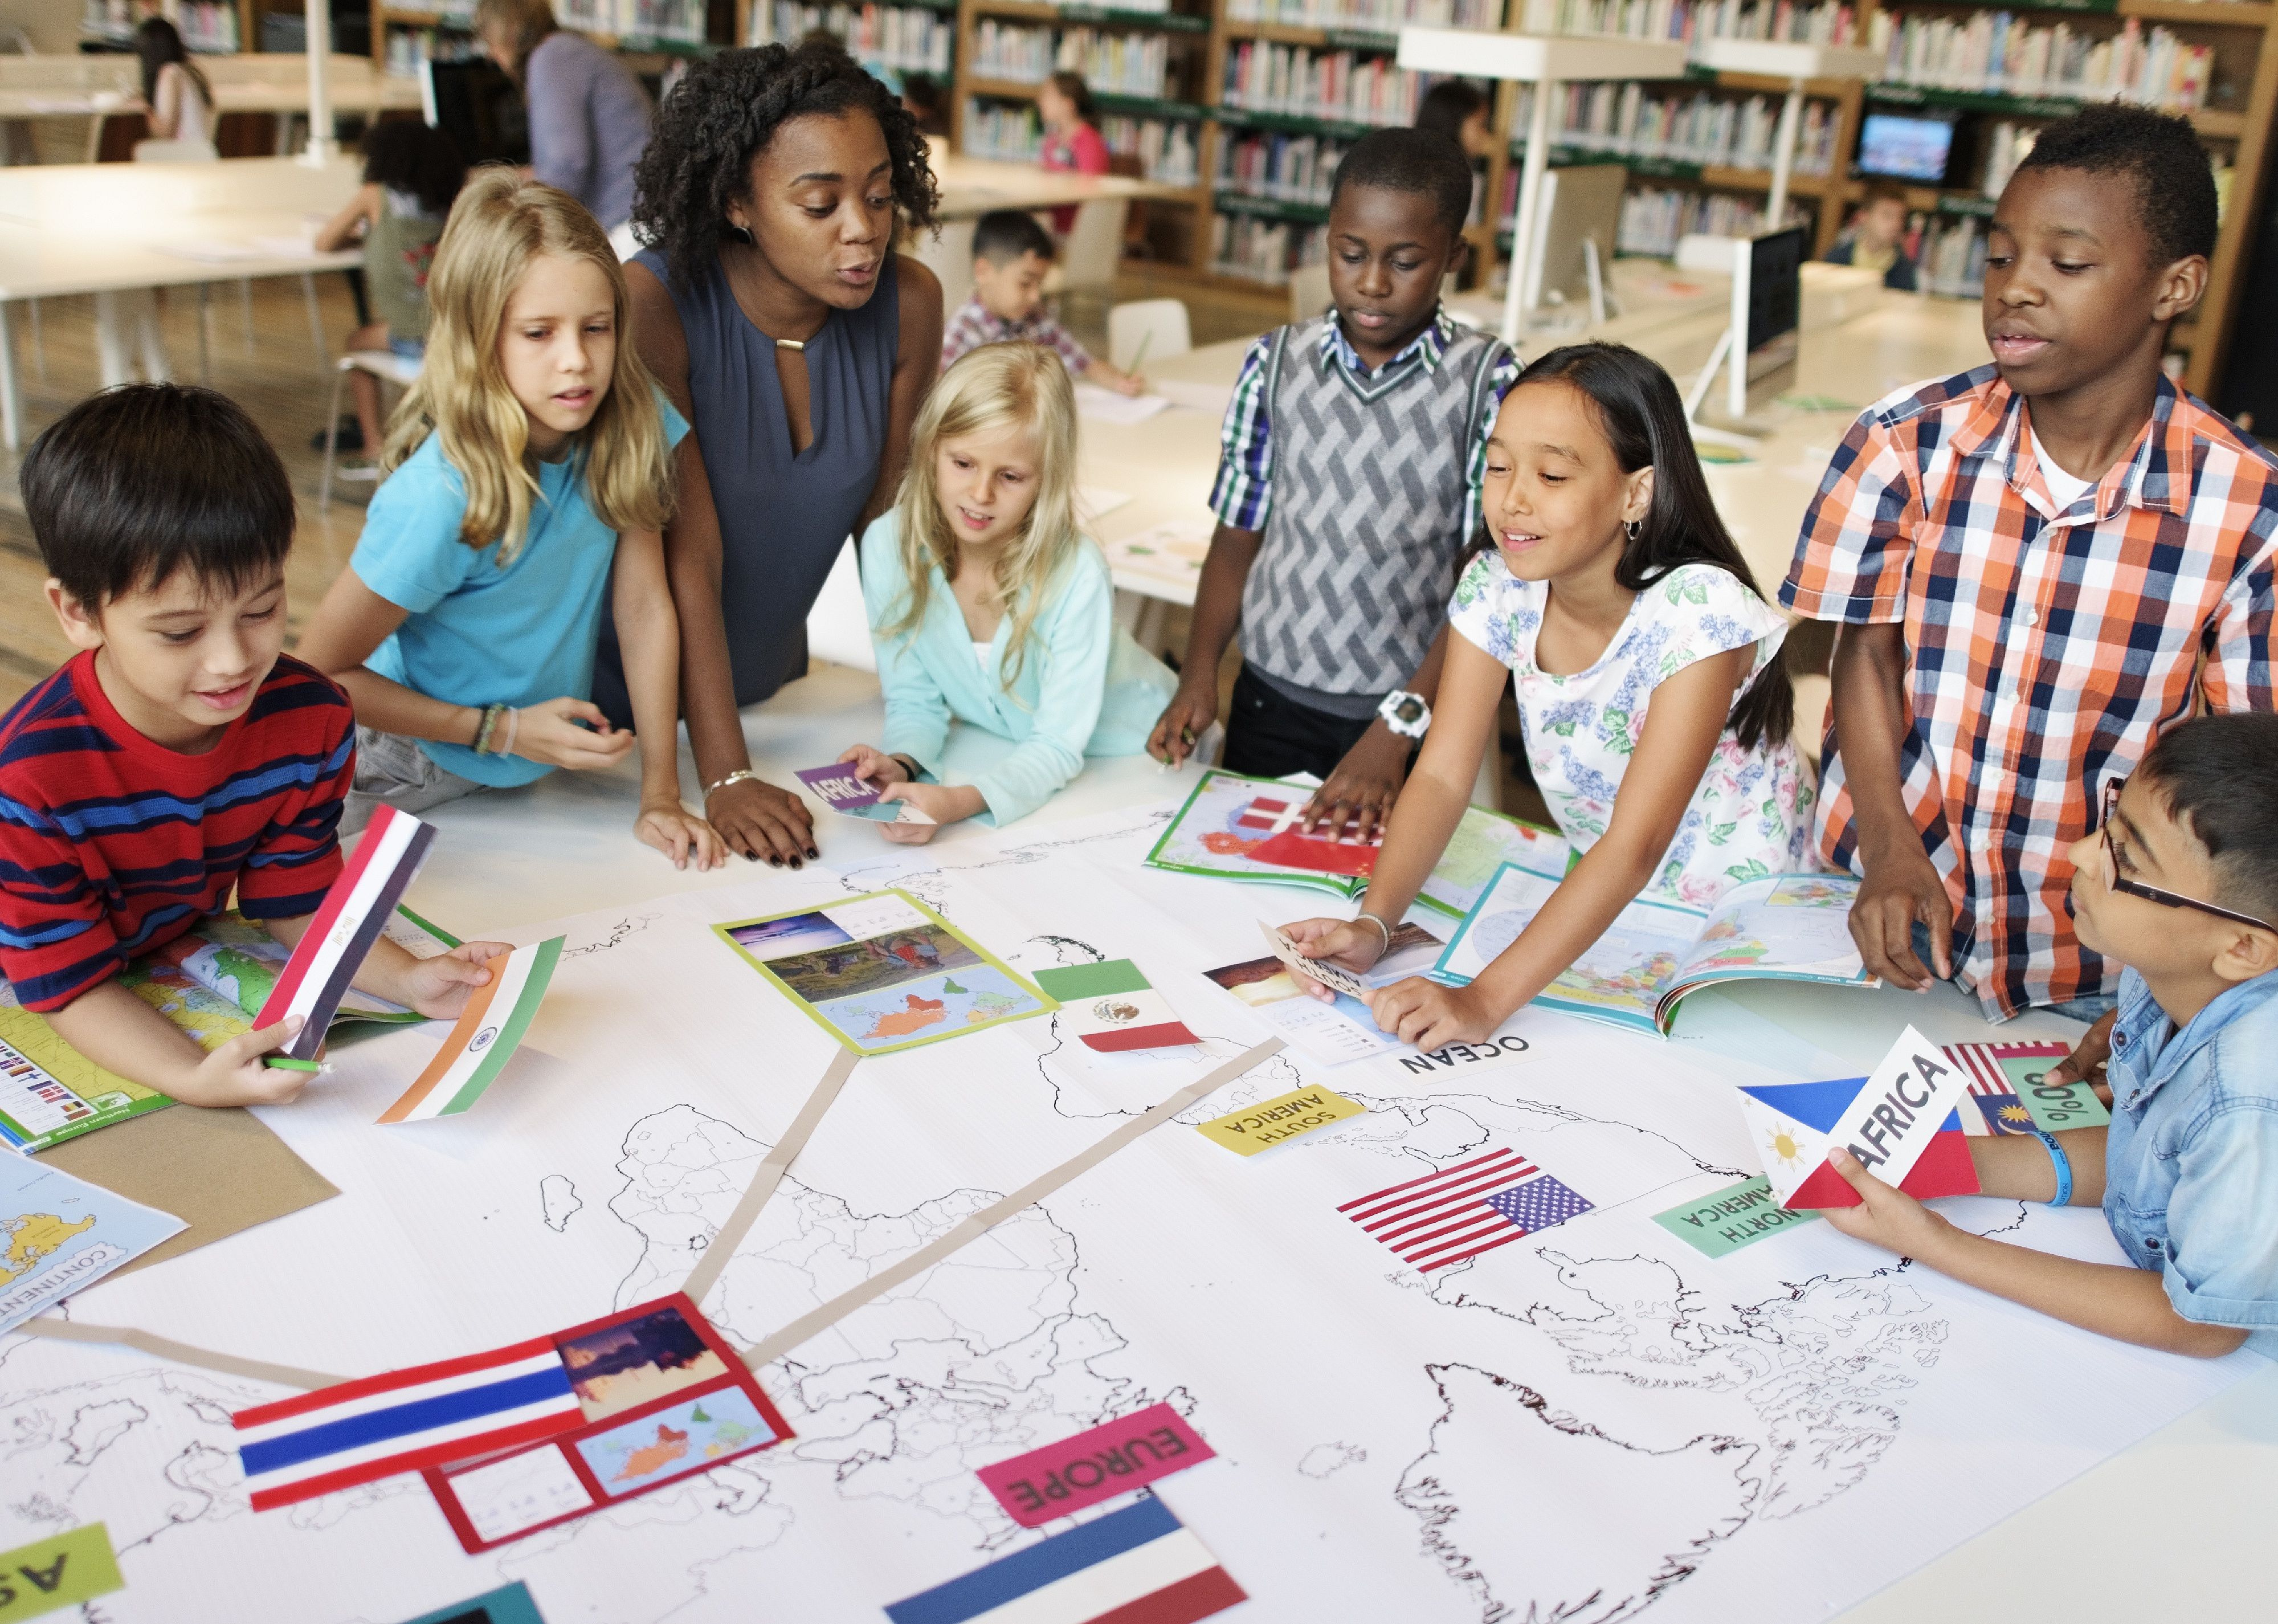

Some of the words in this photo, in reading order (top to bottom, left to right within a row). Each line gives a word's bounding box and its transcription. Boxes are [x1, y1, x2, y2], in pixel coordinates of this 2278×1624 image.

[810, 776, 881, 802] AFRICA
[1295, 958, 1362, 996] SOUTH
[1398, 1035, 1530, 1075] OCEAN
[56, 1121, 88, 1136] Europe
[1224, 1093, 1325, 1133] AMERICA
[1255, 1111, 1337, 1143] SOUTH
[1847, 1054, 1949, 1170] AFRICA
[1679, 1184, 1774, 1228] AMERICA
[1717, 1208, 1802, 1243] NORTH
[1005, 1425, 1191, 1513] EUROPE
